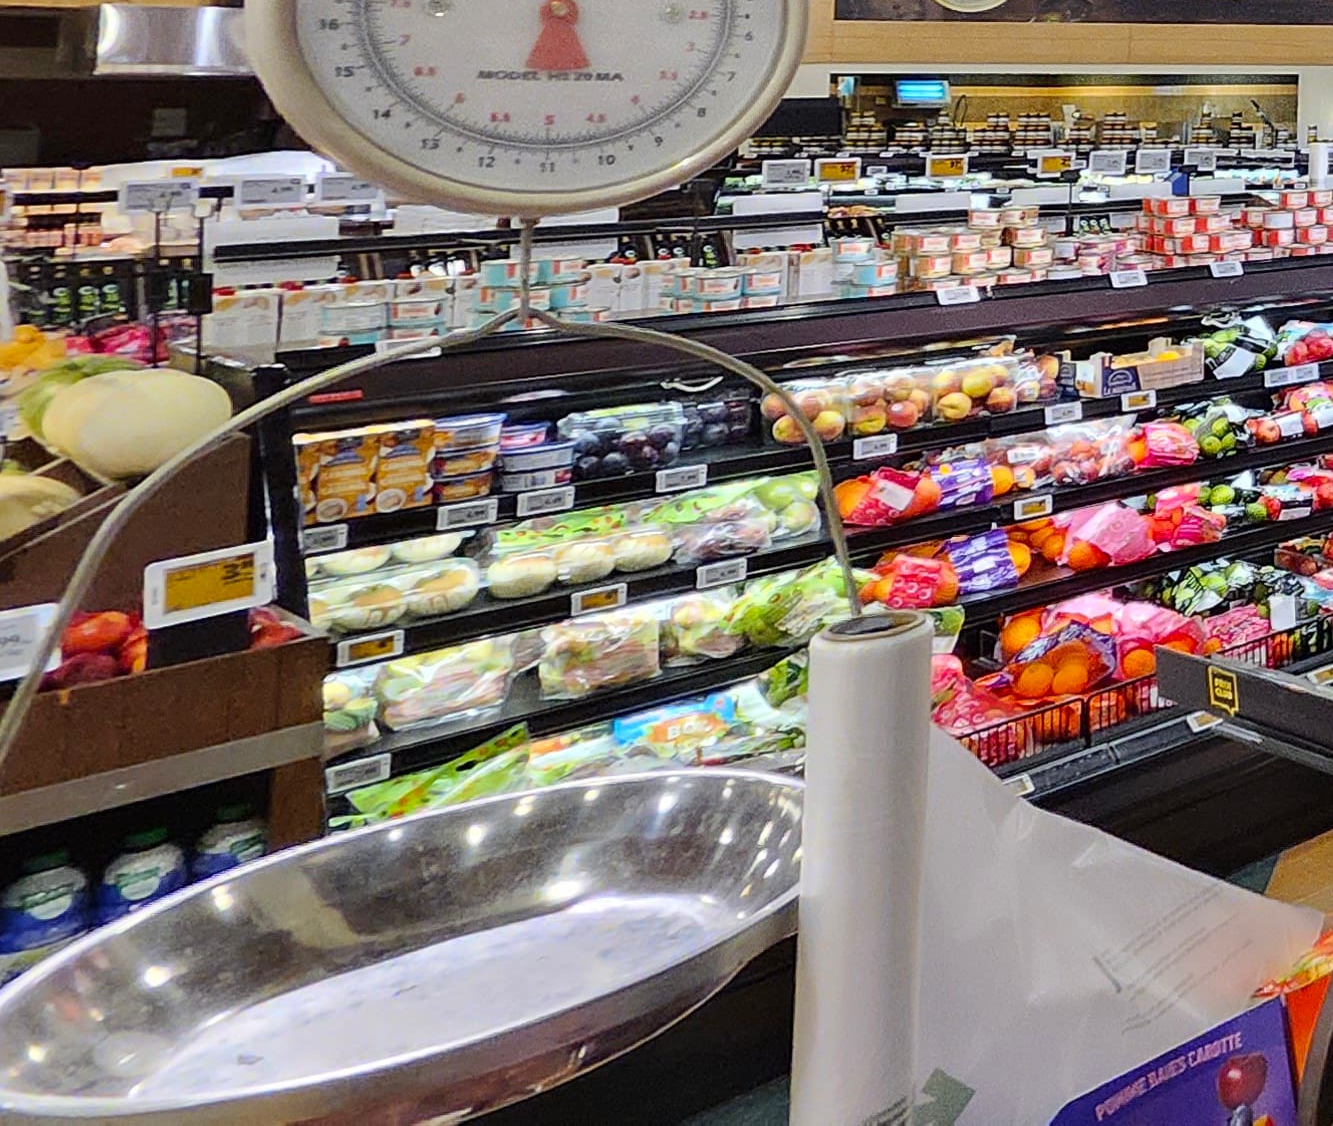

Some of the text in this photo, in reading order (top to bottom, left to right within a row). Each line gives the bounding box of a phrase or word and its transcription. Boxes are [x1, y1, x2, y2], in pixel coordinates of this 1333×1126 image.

[319, 19, 340, 31] 16
[400, 34, 412, 46] 7
[744, 32, 754, 42] 6
[334, 66, 354, 78] 15
[476, 70, 541, 81] MODEL
[726, 71, 737, 82] 7
[373, 108, 392, 120] 14
[696, 106, 707, 118] 8
[421, 138, 440, 150] 13
[654, 135, 664, 147] 9
[478, 156, 496, 168] 12
[598, 153, 616, 166] 10
[1095, 1077, 1147, 1121] POMME
